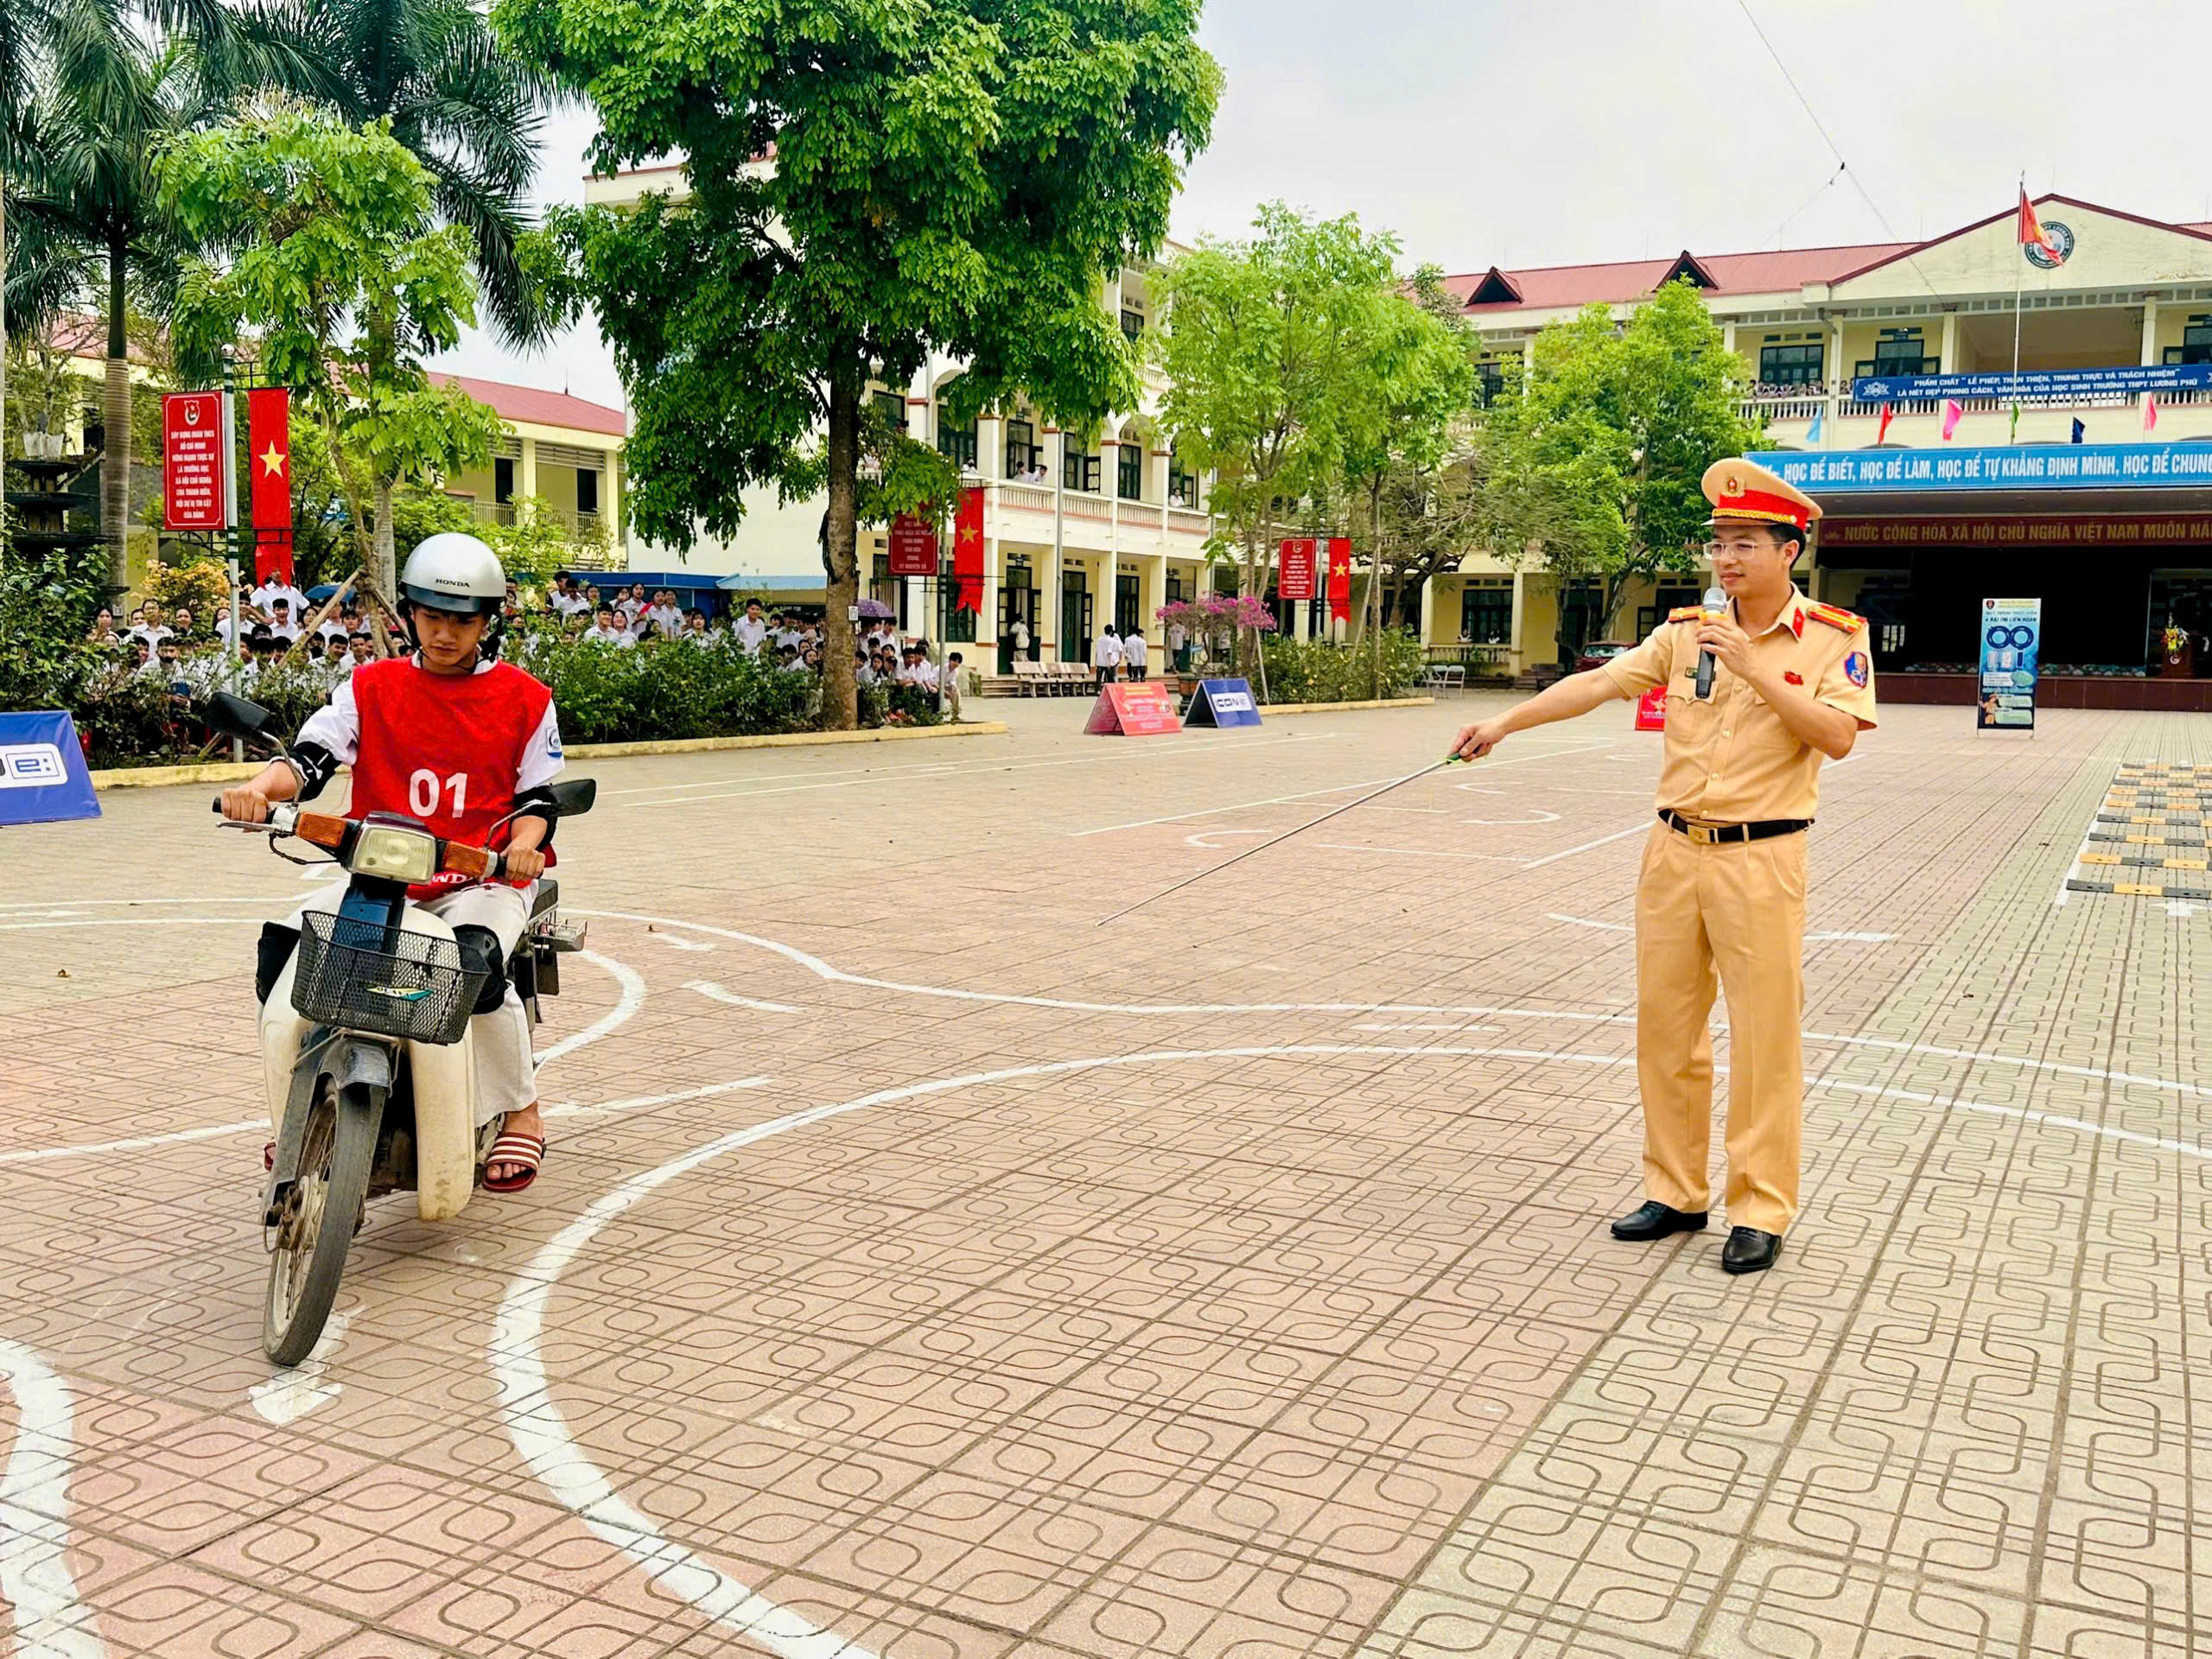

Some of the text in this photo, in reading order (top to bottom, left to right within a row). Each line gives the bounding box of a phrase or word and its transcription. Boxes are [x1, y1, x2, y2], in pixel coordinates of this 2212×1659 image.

[2053, 373, 2080, 382] TRUNG
[2119, 369, 2145, 378] TRÁCH
[1942, 387, 1969, 396] PHONG
[2033, 382, 2050, 392] CỦA
[2052, 382, 2069, 392] HỌC
[2070, 382, 2090, 391] SINH
[2128, 379, 2149, 388] THPT
[1783, 462, 1807, 482] HỌC
[1810, 455, 1827, 480] ĐỂ
[1859, 461, 1884, 481] HỌC
[1886, 454, 1904, 479] ĐỂ
[1904, 455, 1935, 481] LÀM,
[1937, 459, 1961, 481] HỌC
[1964, 452, 1982, 477] ĐỂ
[1984, 456, 2001, 480] TỰ
[2001, 451, 2044, 476] KHẲNG
[2047, 456, 2078, 479] ĐỊNH
[2082, 452, 2120, 476] MÌNH,
[2122, 454, 2149, 478] HỌC
[2152, 447, 2171, 474] ĐỂ
[1845, 519, 2212, 543] NƯỚC CỘNG HÓA XÃ HỘI CHỦ NGHĨA VIỆT NAM MUÔN NĂ
[435, 578, 470, 588] HONDA
[409, 768, 467, 818] 01
